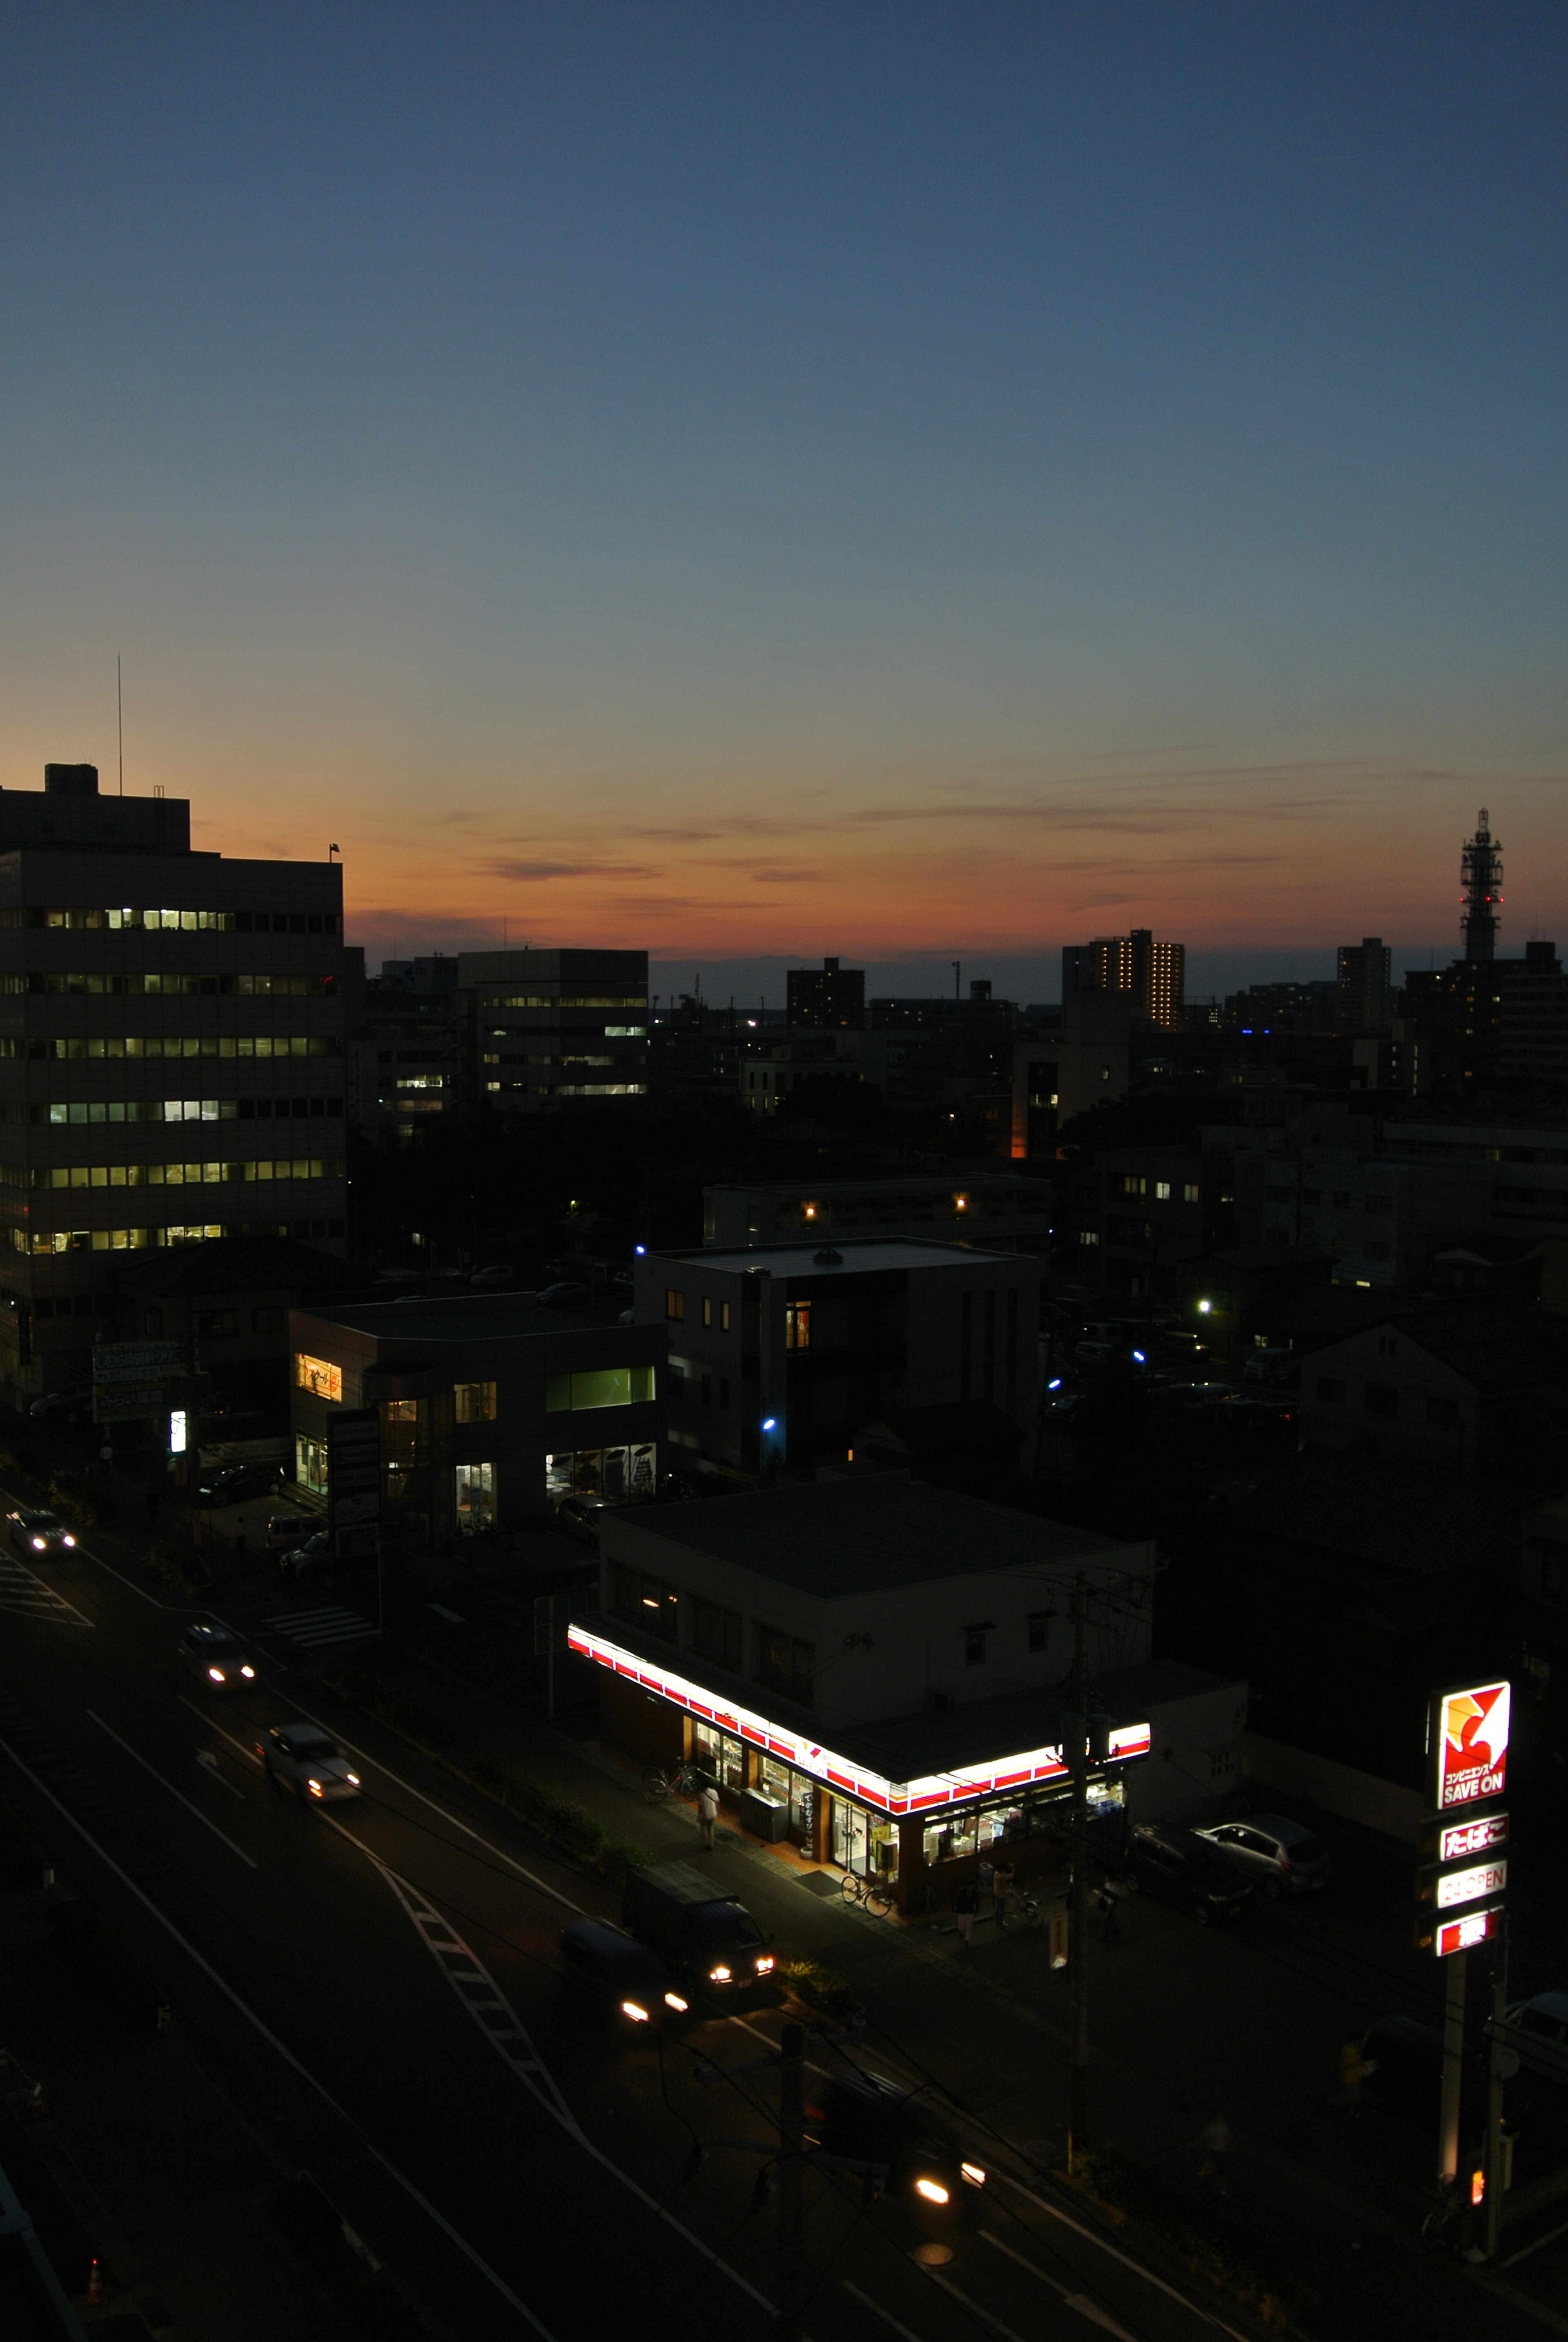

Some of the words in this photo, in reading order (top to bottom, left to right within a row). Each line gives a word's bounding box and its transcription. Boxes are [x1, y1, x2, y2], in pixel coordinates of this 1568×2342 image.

[1444, 1779, 1479, 1803] SAVE
[1481, 1772, 1503, 1793] ON
[1446, 1764, 1490, 1785] コンビニエンス
[1446, 1822, 1506, 1857] たばこ
[1445, 1881, 1461, 1901] 24
[1466, 1868, 1503, 1893] OPEN
